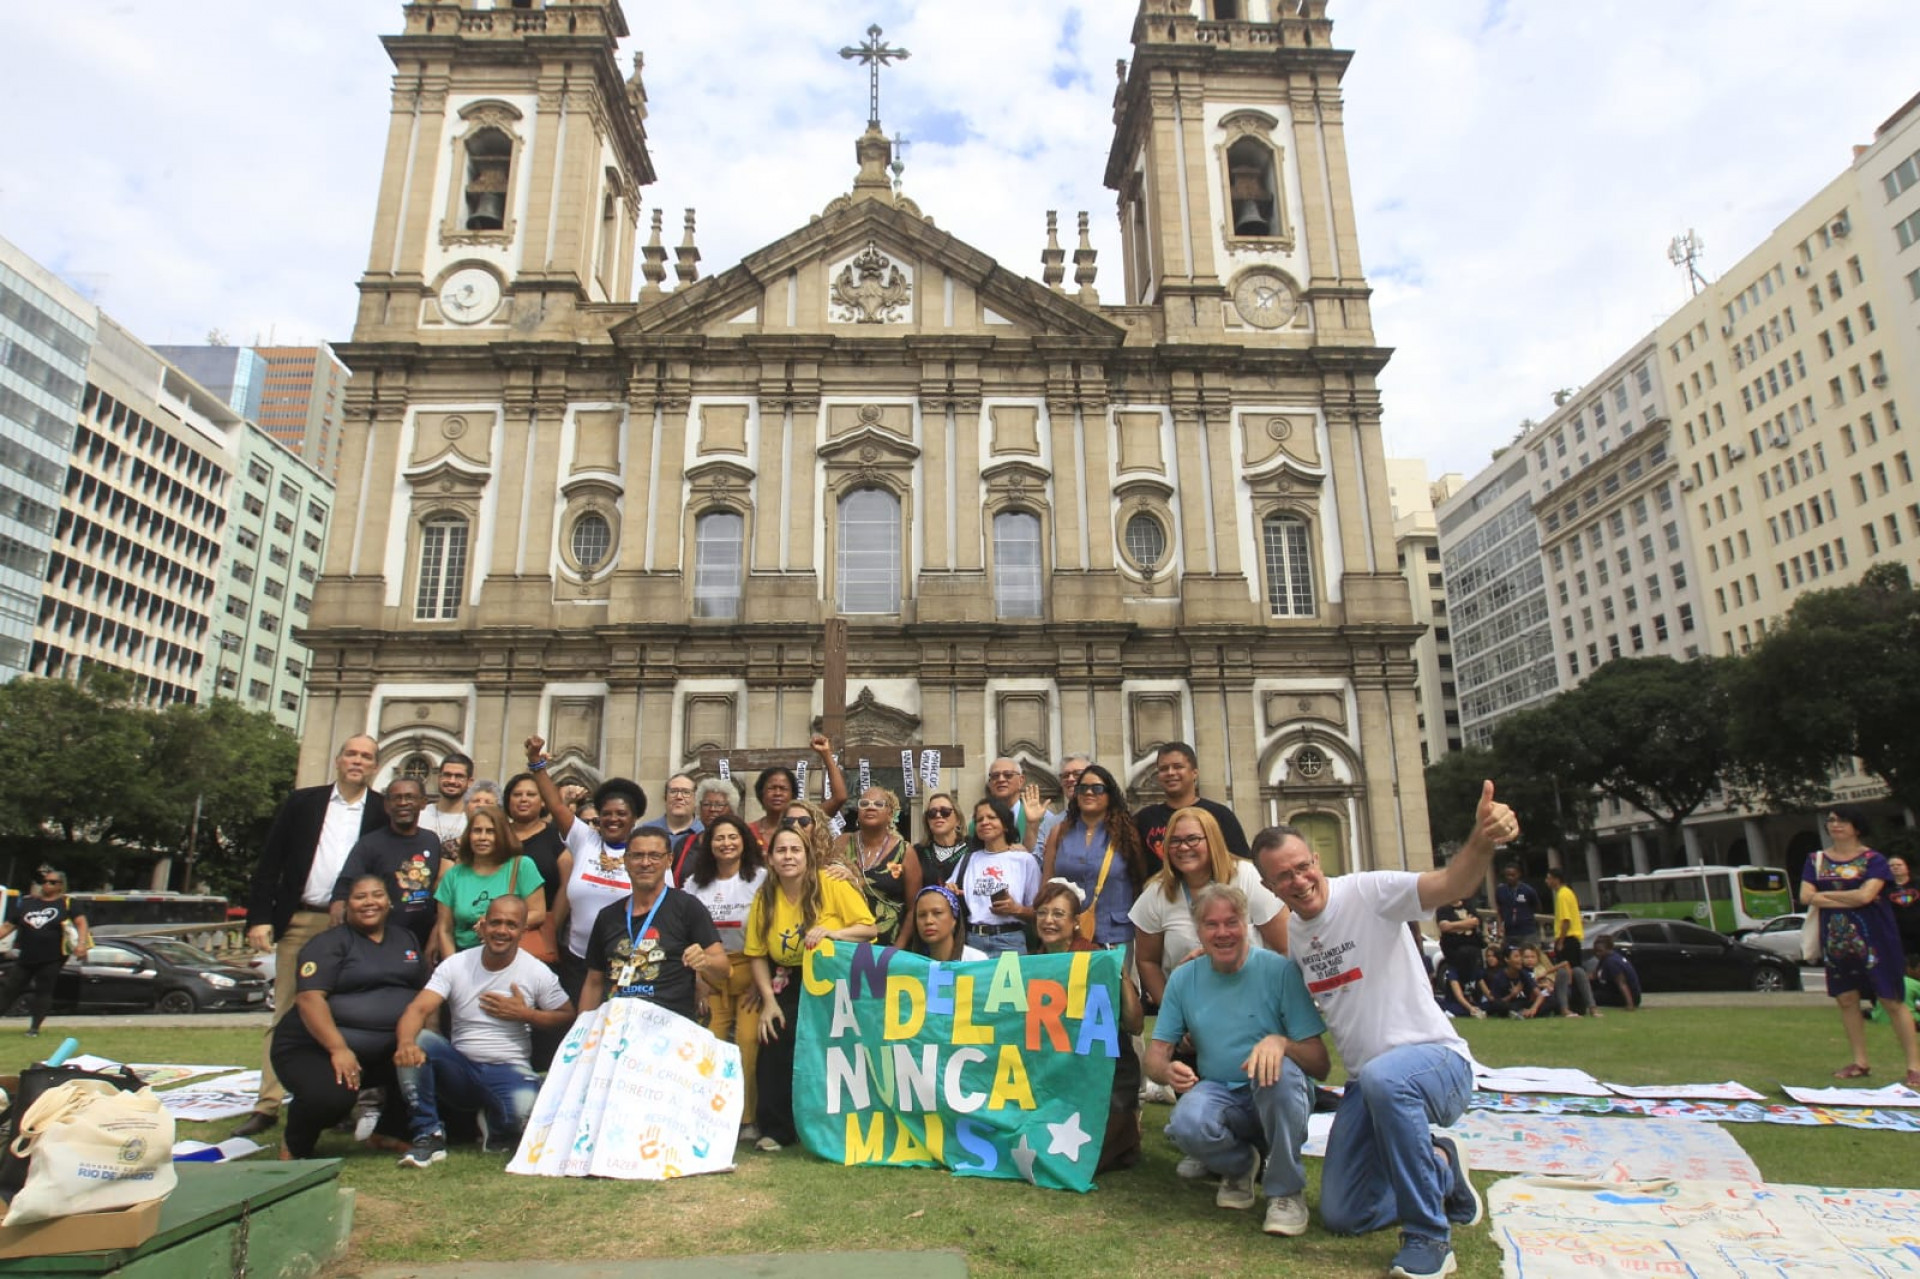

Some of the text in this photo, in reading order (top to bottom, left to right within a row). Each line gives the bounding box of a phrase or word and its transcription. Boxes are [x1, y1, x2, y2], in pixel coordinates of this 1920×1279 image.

[802, 938, 1120, 1057] CANDELARIA
[617, 1077, 664, 1102] DIREITO
[826, 1043, 1037, 1114] NUNCA
[844, 1112, 999, 1172] MAIS
[78, 1168, 99, 1178] RIO
